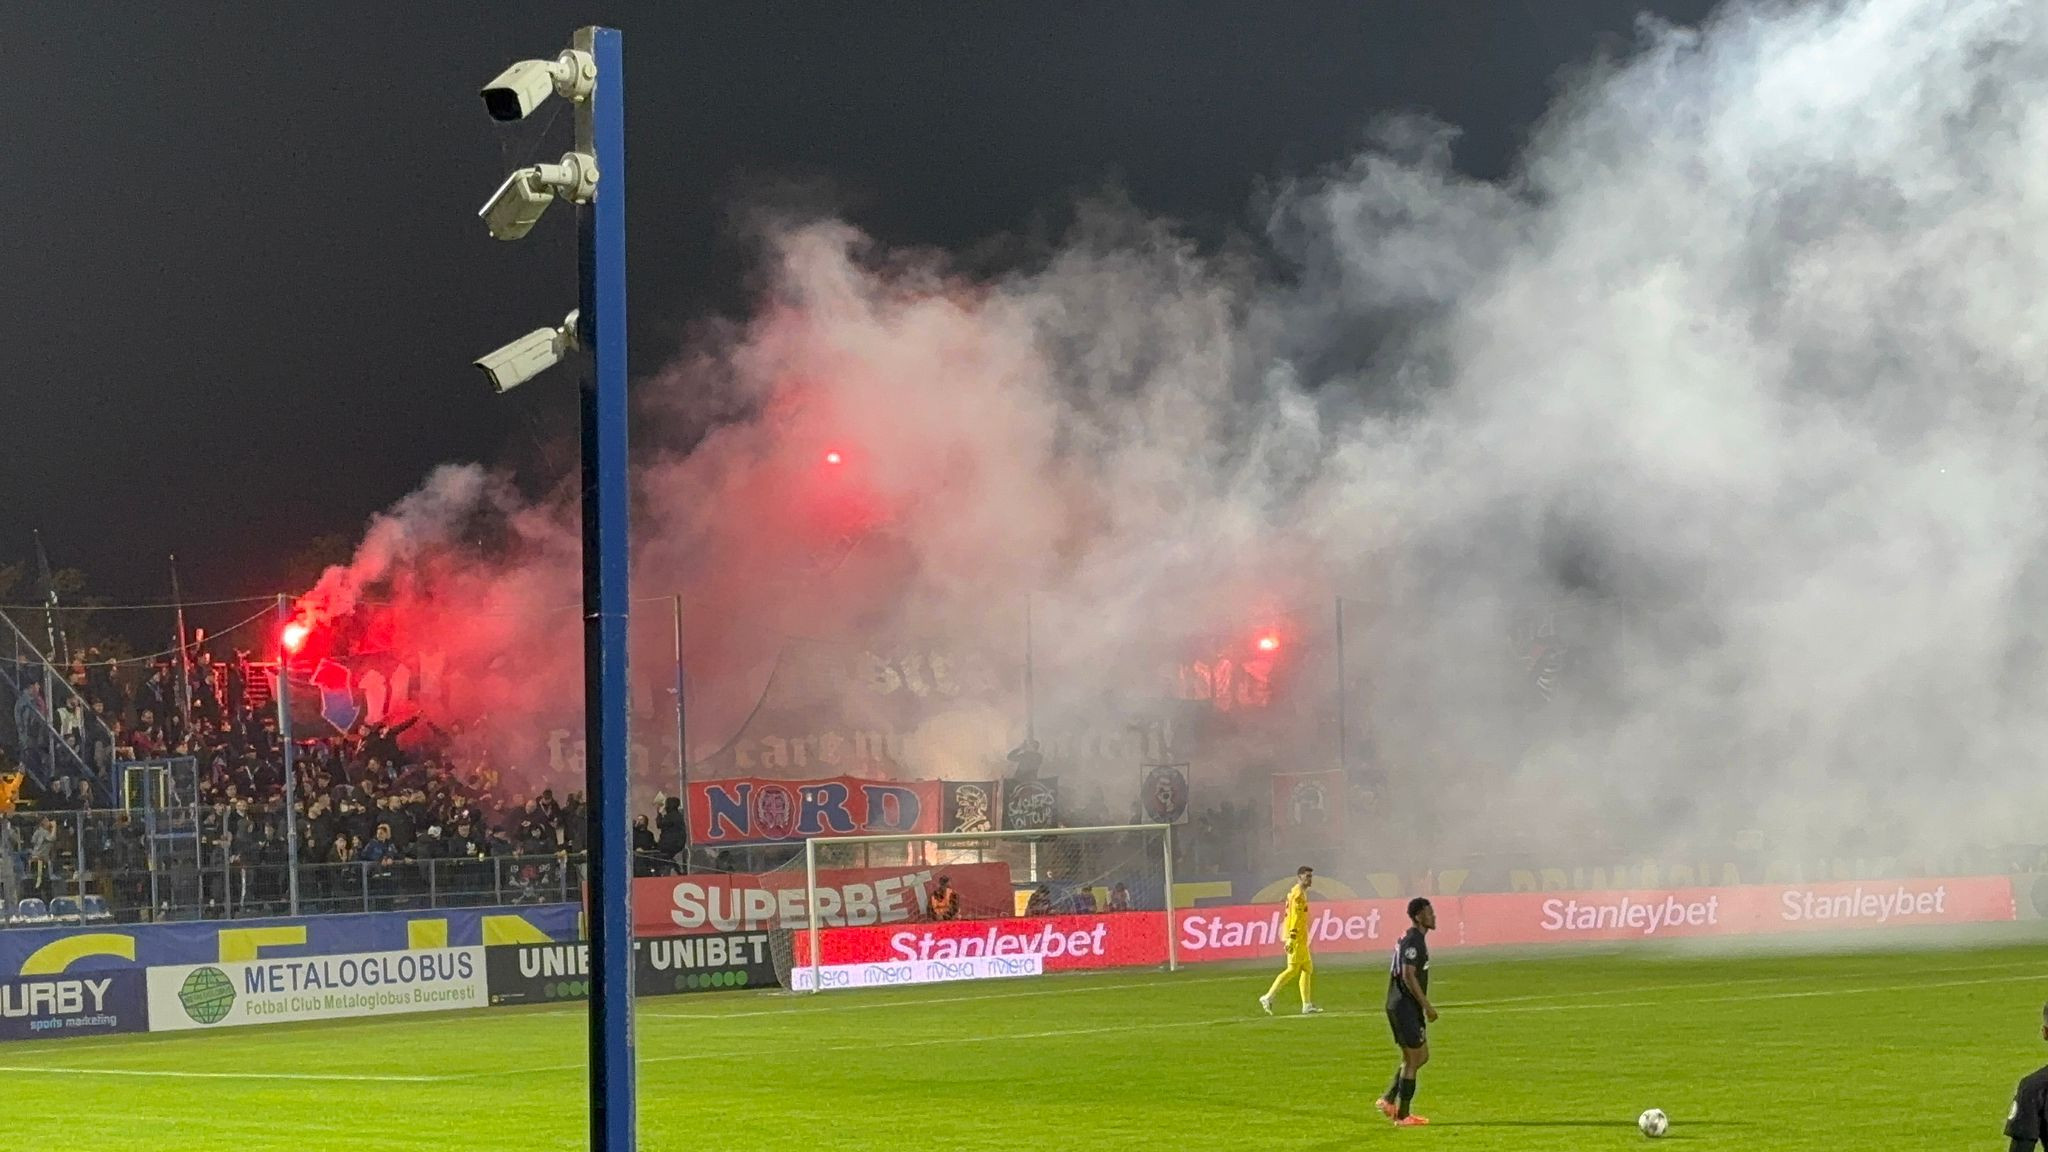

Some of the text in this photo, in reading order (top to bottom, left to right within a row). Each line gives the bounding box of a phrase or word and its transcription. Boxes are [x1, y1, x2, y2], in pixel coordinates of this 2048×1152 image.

[704, 782, 922, 840] NORD
[671, 870, 935, 932] SUPERBET
[1540, 895, 1719, 935] Stanleybet
[1781, 885, 1946, 923] Stanleybet
[889, 922, 1107, 962] Stanleybet
[1181, 909, 1381, 950] Stanlybet
[650, 934, 767, 970] UNIBET
[800, 956, 1035, 988] riera riviera riviera riviera
[245, 952, 473, 994] METALOGLOBUS
[0, 978, 112, 1018] URBY
[246, 985, 475, 1015] Fotbal Club Metaloglobus Bucuresti
[30, 1013, 117, 1032] sports marketing
